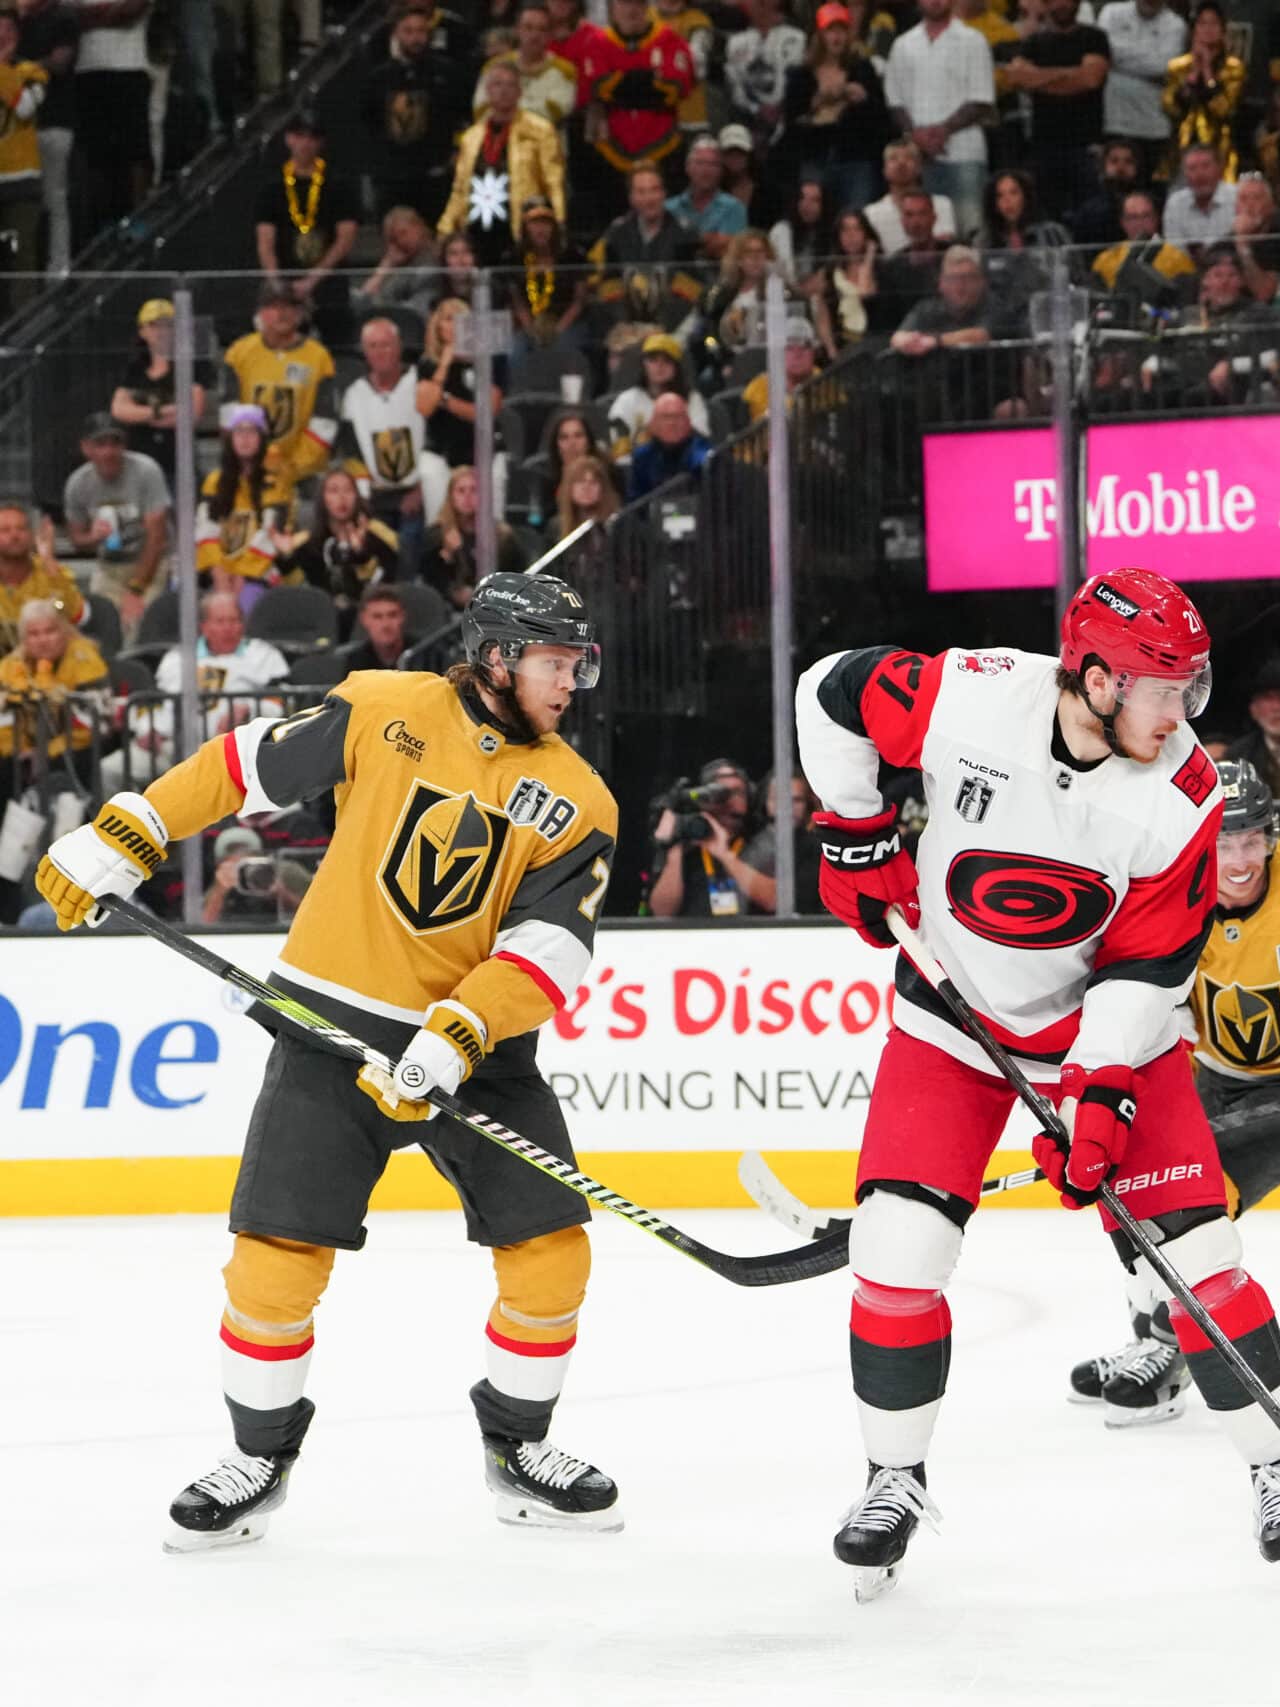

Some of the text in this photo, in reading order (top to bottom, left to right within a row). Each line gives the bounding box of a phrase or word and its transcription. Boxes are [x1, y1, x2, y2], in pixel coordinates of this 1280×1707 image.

[1096, 584, 1138, 616] Lenovo
[1183, 610, 1201, 634] 21
[383, 720, 426, 752] Circa
[394, 743, 423, 763] SPORTS
[958, 757, 1010, 782] NUCOR
[537, 798, 575, 841] A
[821, 832, 900, 864] CCM
[466, 1112, 670, 1235] WARRIOR
